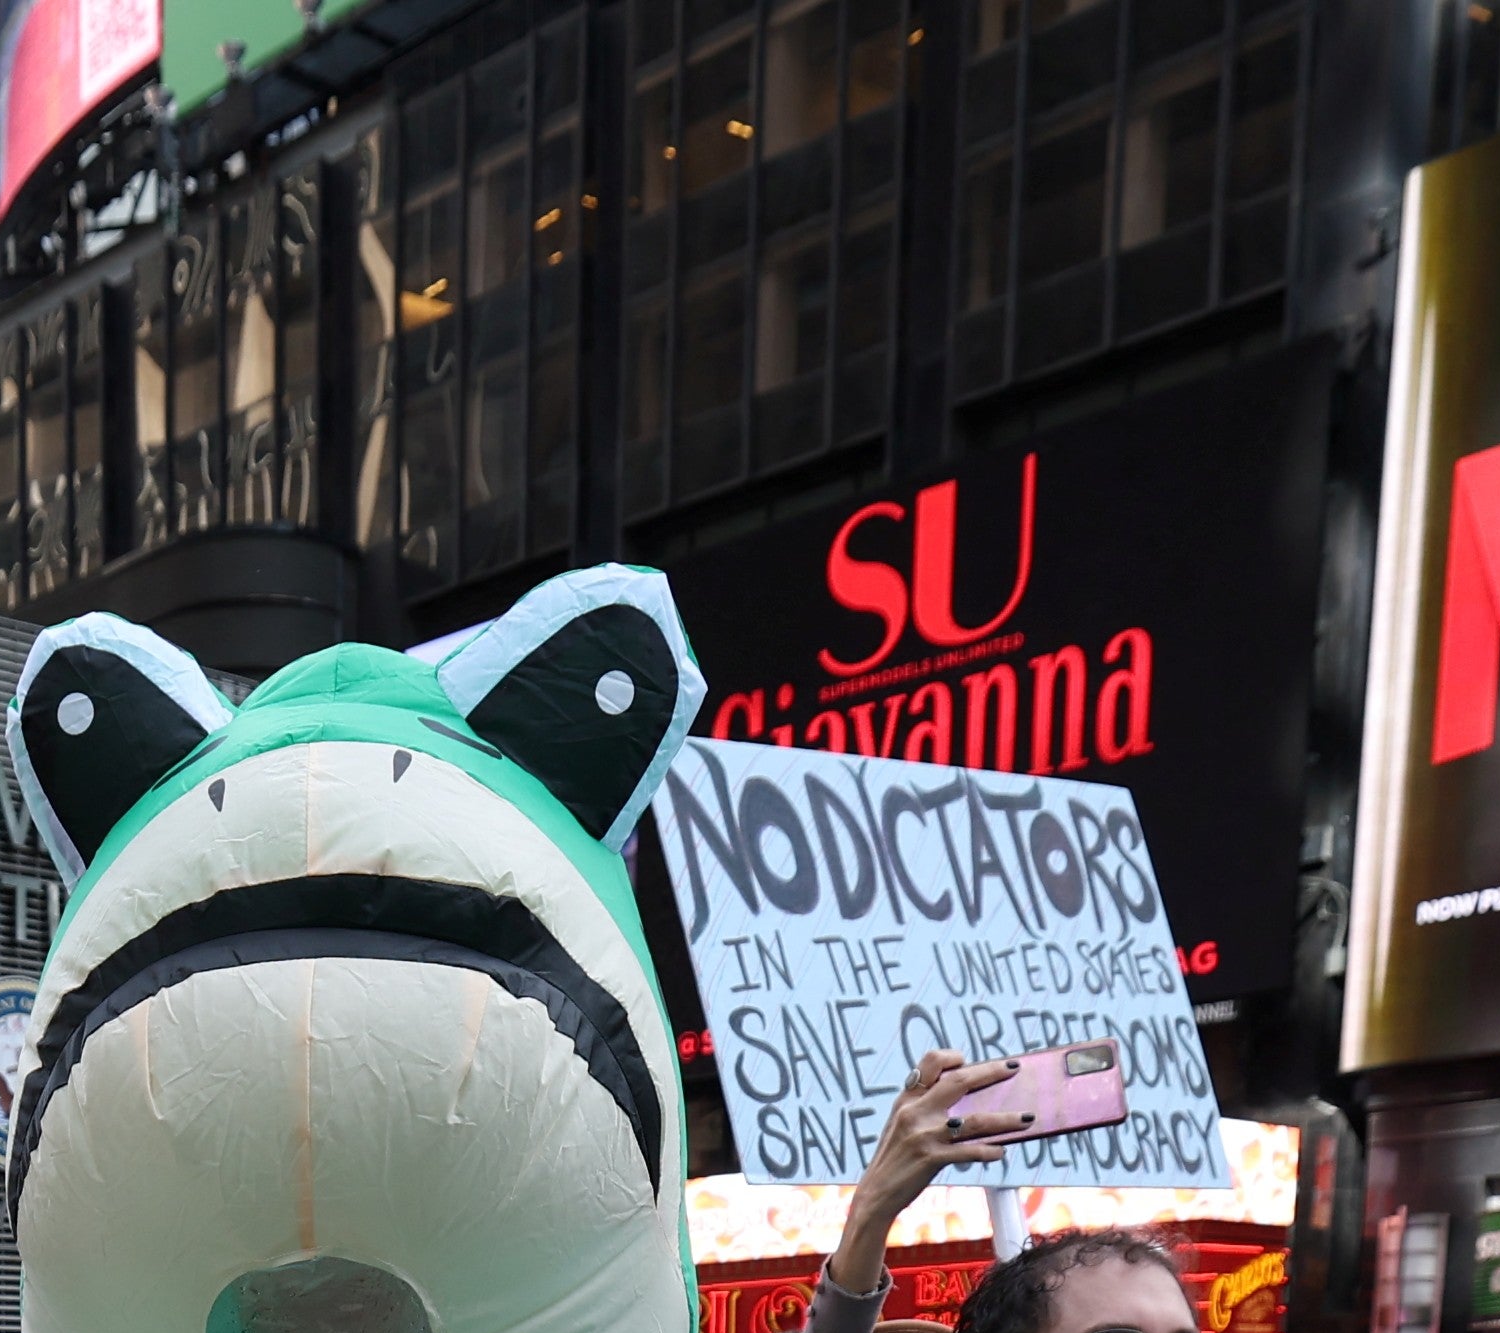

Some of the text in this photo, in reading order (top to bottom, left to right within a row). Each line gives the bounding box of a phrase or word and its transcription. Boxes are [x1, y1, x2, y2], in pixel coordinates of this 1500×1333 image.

[664, 736, 1157, 945] NO DICTATORS
[1415, 890, 1479, 926] NOW
[722, 930, 1176, 999] IN THE UNITED STATES
[726, 1000, 899, 1103] SAVE
[757, 1103, 878, 1181] SAVE
